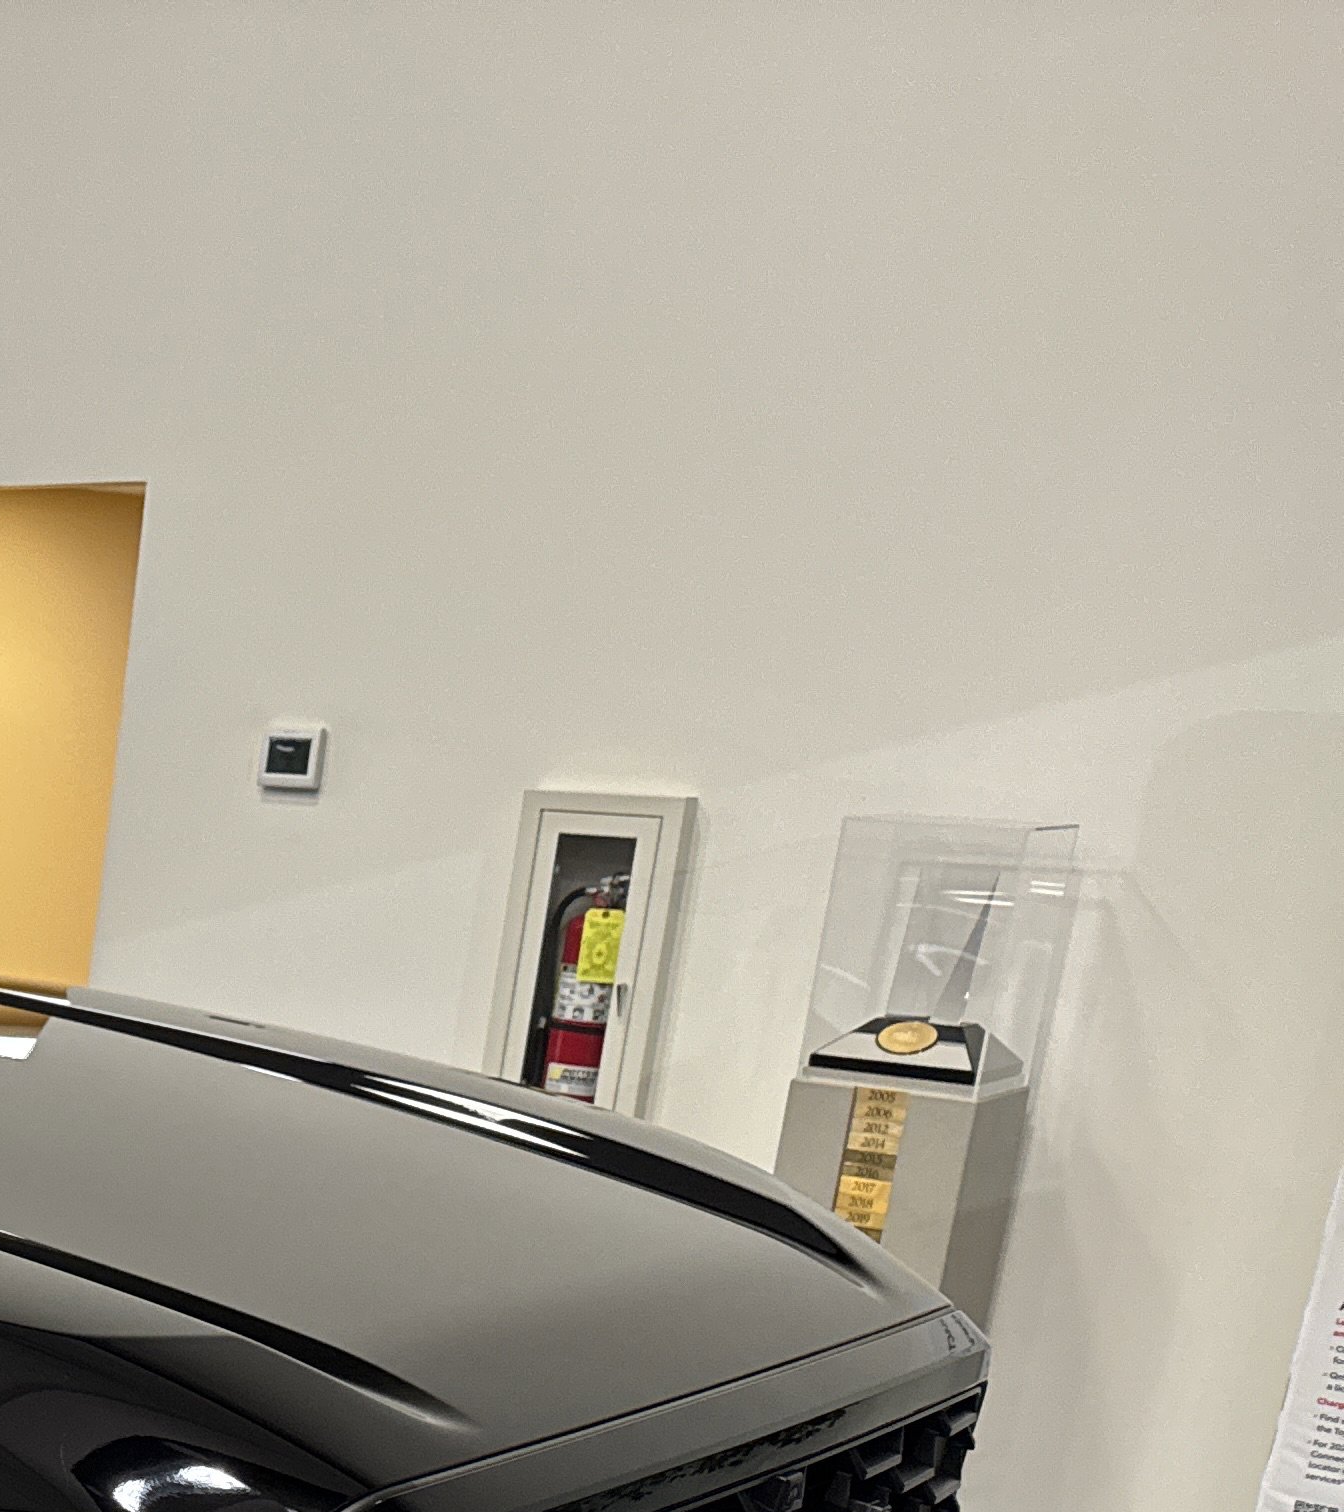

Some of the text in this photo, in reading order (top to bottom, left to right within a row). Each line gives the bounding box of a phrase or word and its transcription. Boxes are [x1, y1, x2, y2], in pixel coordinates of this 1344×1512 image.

[868, 1089, 897, 1104] 2005
[864, 1106, 893, 1119] 2006
[863, 1122, 890, 1136] 2012
[860, 1137, 886, 1150] 2014
[852, 1180, 877, 1194] 2017
[845, 1211, 871, 1225] 2019
[1317, 1397, 1344, 1410] Charg
